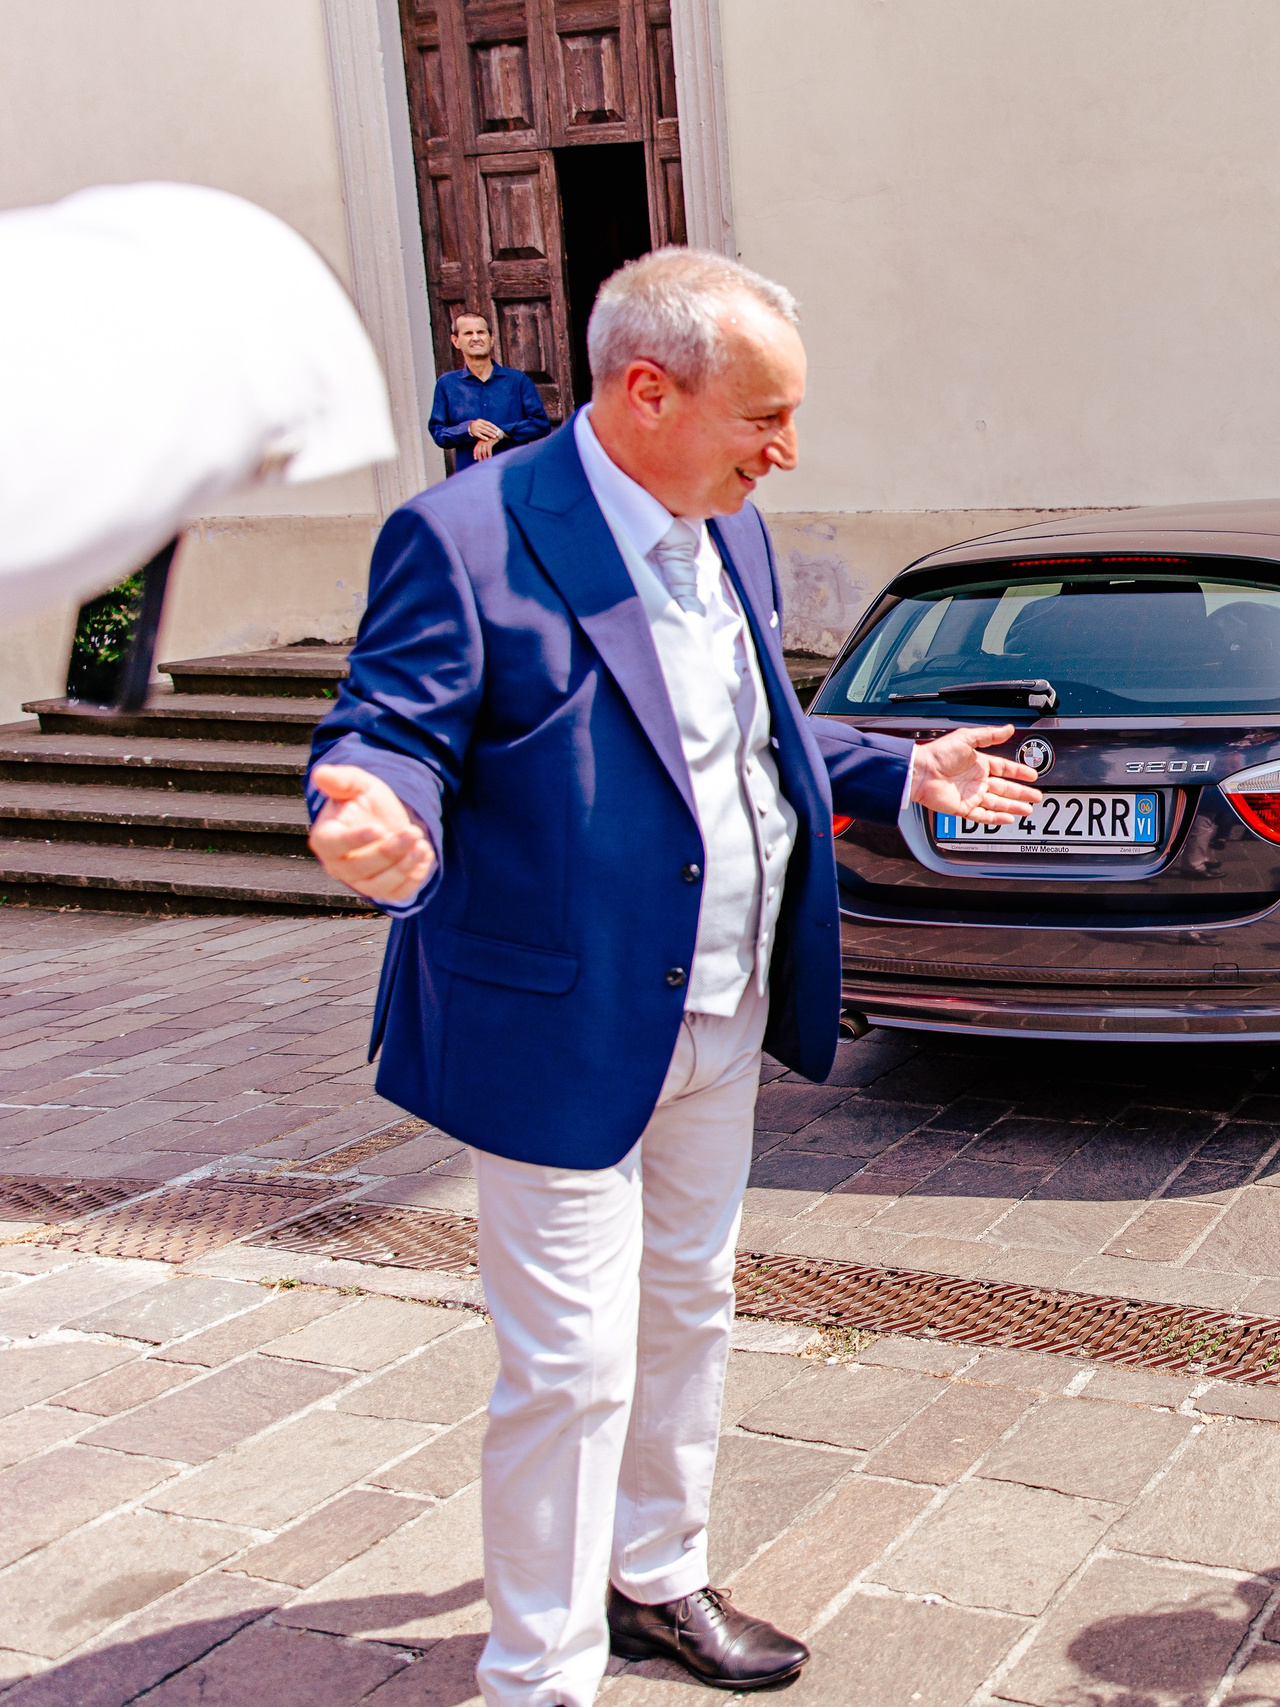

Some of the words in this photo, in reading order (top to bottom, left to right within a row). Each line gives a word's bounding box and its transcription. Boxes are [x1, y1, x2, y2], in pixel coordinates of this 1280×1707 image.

[1021, 741, 1047, 753] BMW
[1140, 802, 1151, 812] 06
[1137, 818, 1151, 835] VI
